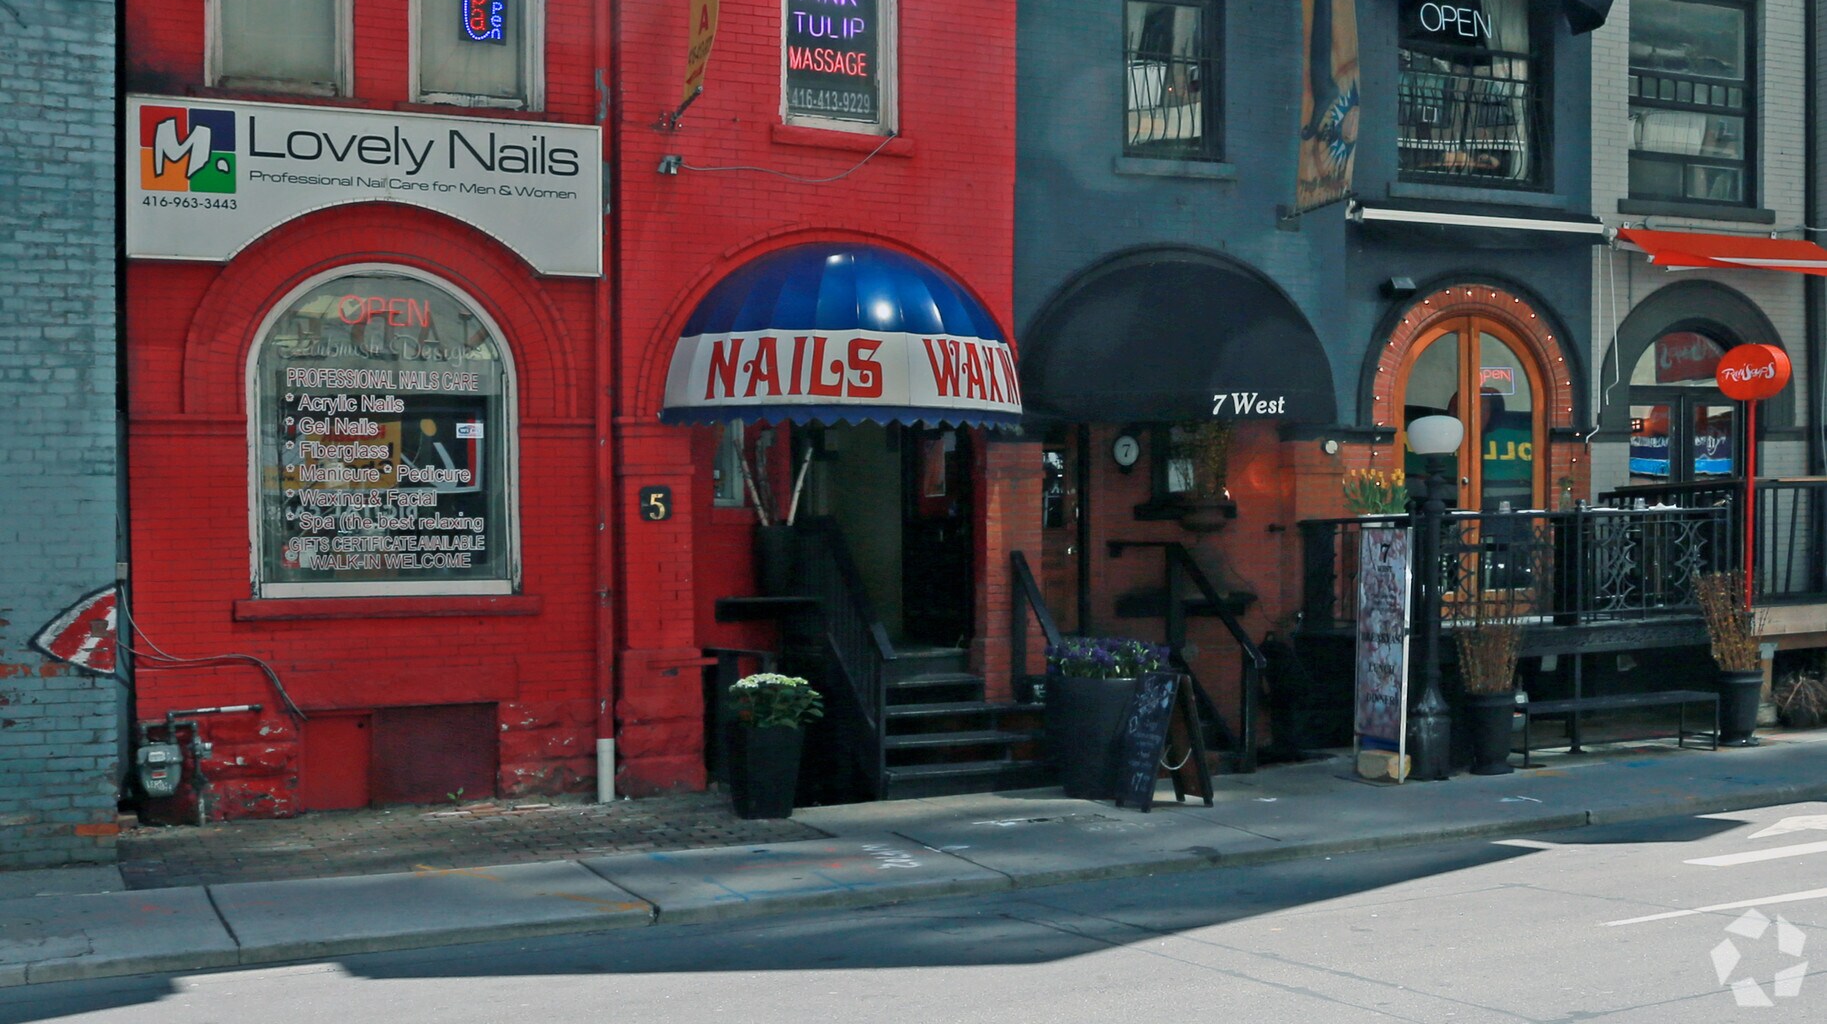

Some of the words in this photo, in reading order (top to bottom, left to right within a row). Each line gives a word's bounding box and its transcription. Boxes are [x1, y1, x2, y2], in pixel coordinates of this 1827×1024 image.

[794, 11, 865, 39] TULIP
[1420, 2, 1492, 39] OPEN
[789, 45, 868, 77] MASSAGE
[791, 87, 870, 113] 416-413-9229
[249, 115, 435, 175] Lovely
[449, 129, 580, 177] Nails
[250, 170, 353, 188] Professional
[356, 174, 386, 189] Nail
[389, 178, 429, 192] Care
[432, 180, 457, 193] for
[459, 182, 495, 195] Men
[499, 185, 512, 195] &
[514, 186, 577, 200] Women
[142, 196, 237, 210] 416-963-3443
[338, 294, 429, 327] OPEN
[705, 336, 883, 400] NAILS
[287, 368, 396, 390] PROFESSIONAL
[399, 370, 439, 390] NAILS
[442, 371, 479, 391] CARE
[298, 394, 357, 416] Acrylic
[361, 395, 405, 413] Nails
[1212, 394, 1227, 415] 7
[1231, 392, 1285, 415] West
[300, 416, 330, 435] Gel
[334, 417, 379, 436] Nails
[300, 441, 390, 462] Fiberglass
[1122, 443, 1131, 458] 7
[300, 464, 380, 483] Manicure
[397, 465, 472, 483] Pedicure
[300, 489, 363, 510] Waxing
[369, 490, 382, 507] &
[387, 490, 437, 507] Facial
[649, 493, 665, 520] 5
[299, 512, 334, 534] Spa
[339, 512, 376, 533] (the
[378, 512, 416, 530] best
[418, 512, 484, 532] relaxing
[289, 536, 329, 553] GIFTS
[332, 536, 418, 552] CERTIFICATE
[418, 535, 485, 550] AVAILABLE
[1380, 543, 1391, 563] 7
[310, 553, 381, 570] WALK-IN
[384, 553, 471, 568] WELCOME
[1368, 662, 1395, 674] LUNCH
[1366, 693, 1395, 705] DINNER
